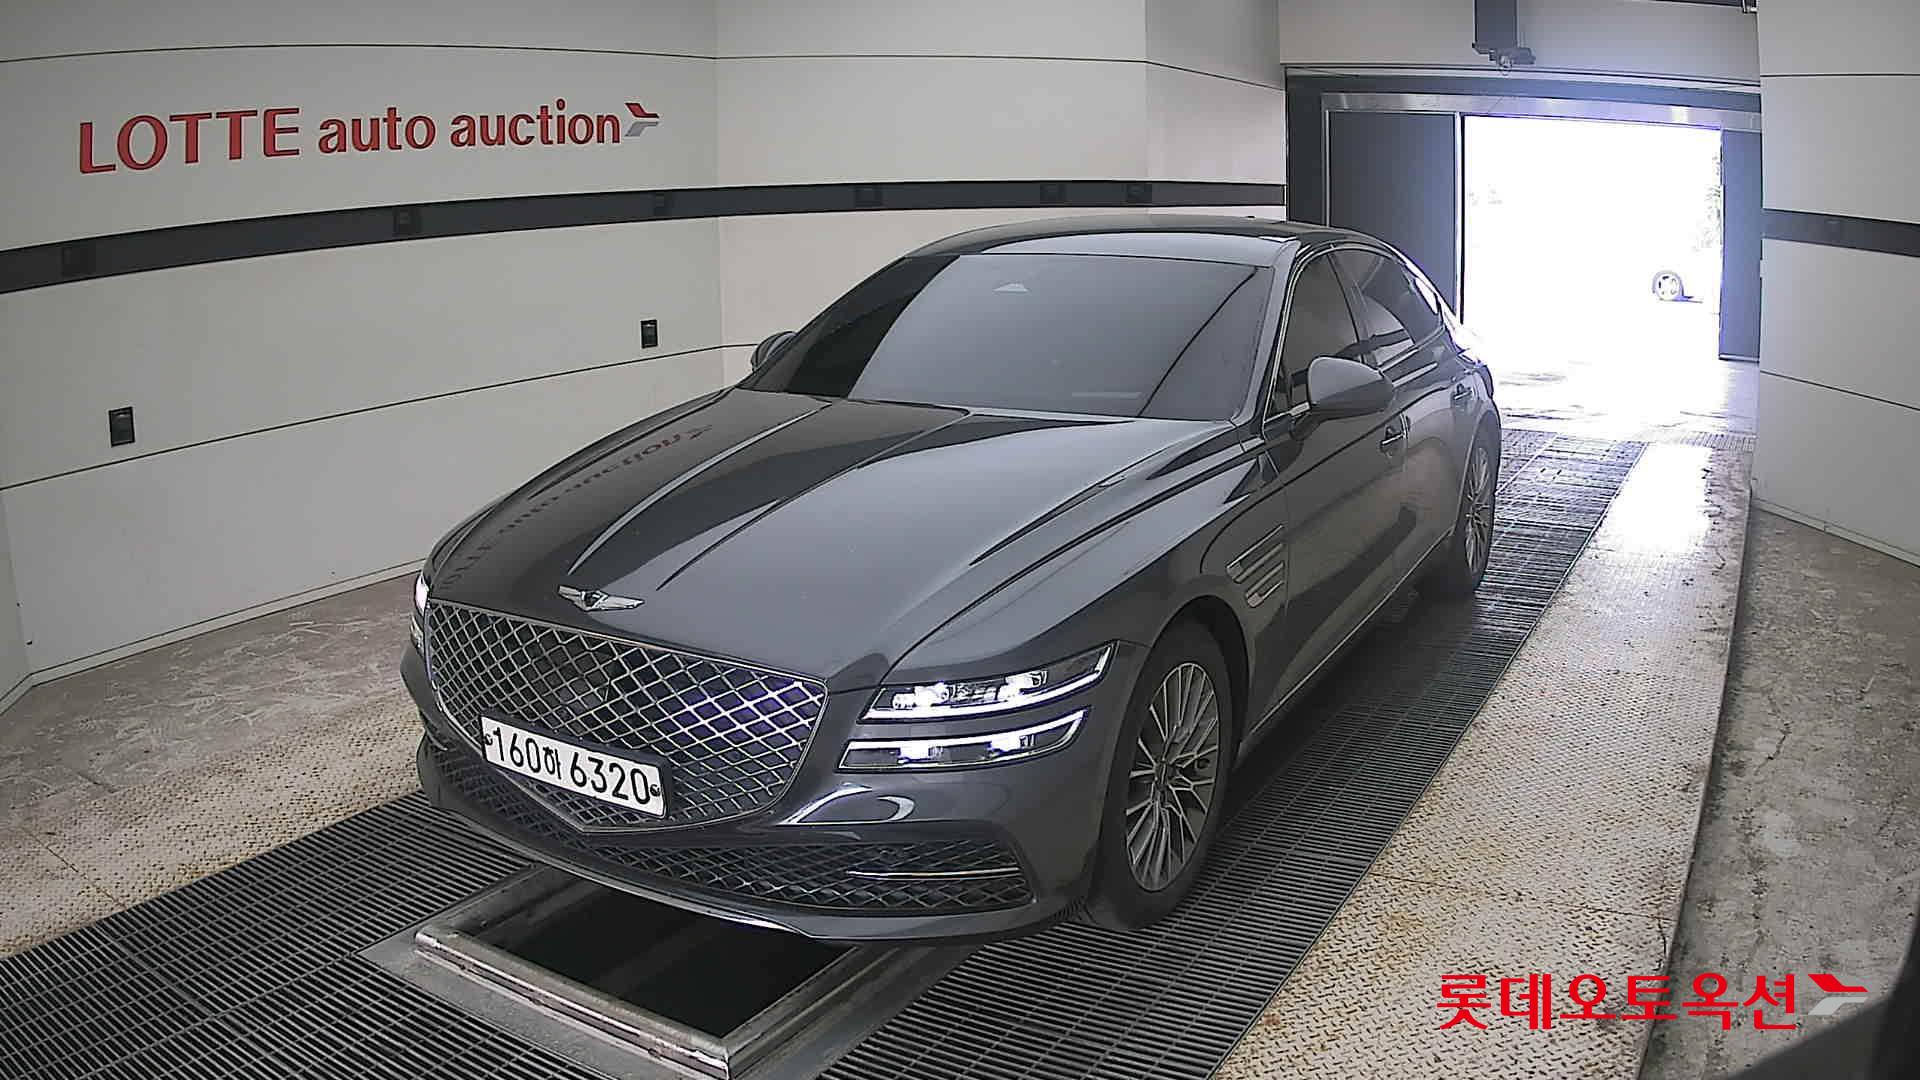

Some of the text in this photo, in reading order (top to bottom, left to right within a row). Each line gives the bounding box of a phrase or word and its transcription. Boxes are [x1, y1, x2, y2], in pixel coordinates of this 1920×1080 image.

[79, 98, 622, 174] LOTTE auto auction
[493, 726, 650, 805] 160하 6320
